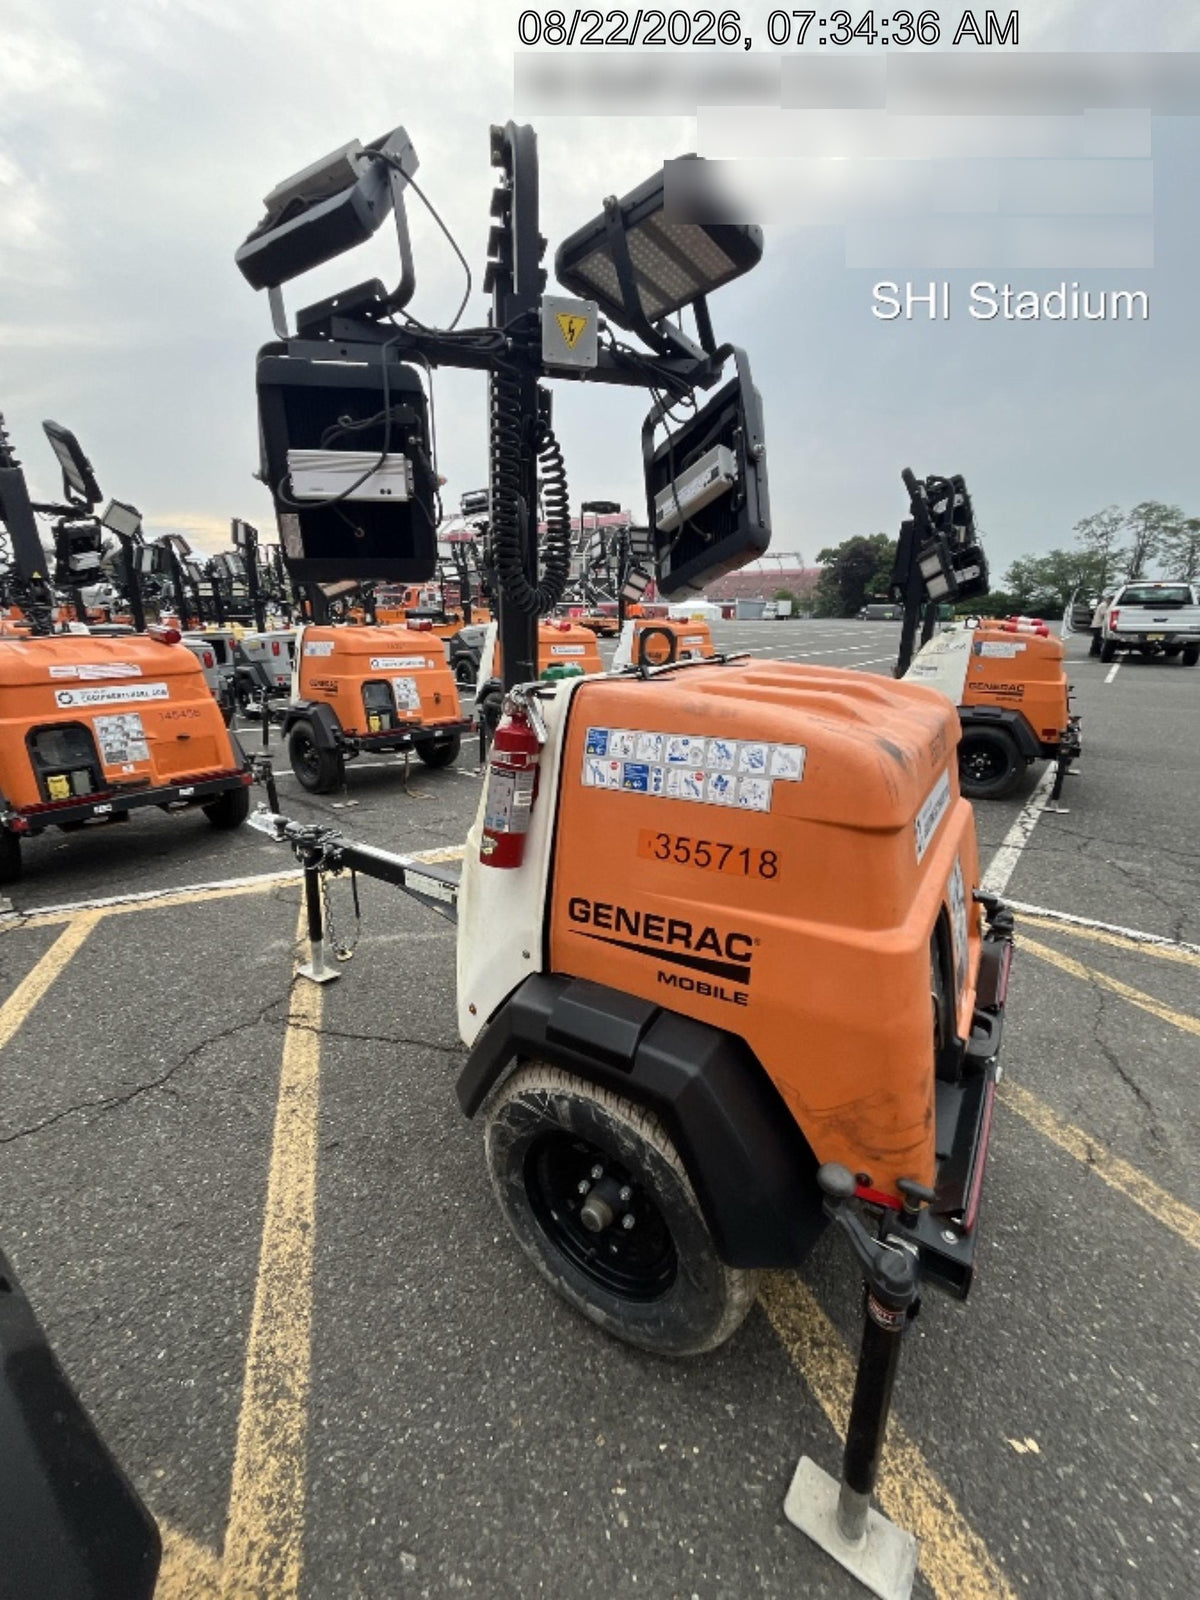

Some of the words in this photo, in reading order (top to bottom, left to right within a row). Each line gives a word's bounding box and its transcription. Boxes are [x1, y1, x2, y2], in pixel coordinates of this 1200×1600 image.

[655, 833, 778, 879] 355718
[568, 897, 753, 963] GENERAC
[657, 970, 749, 1007] MOBILE
